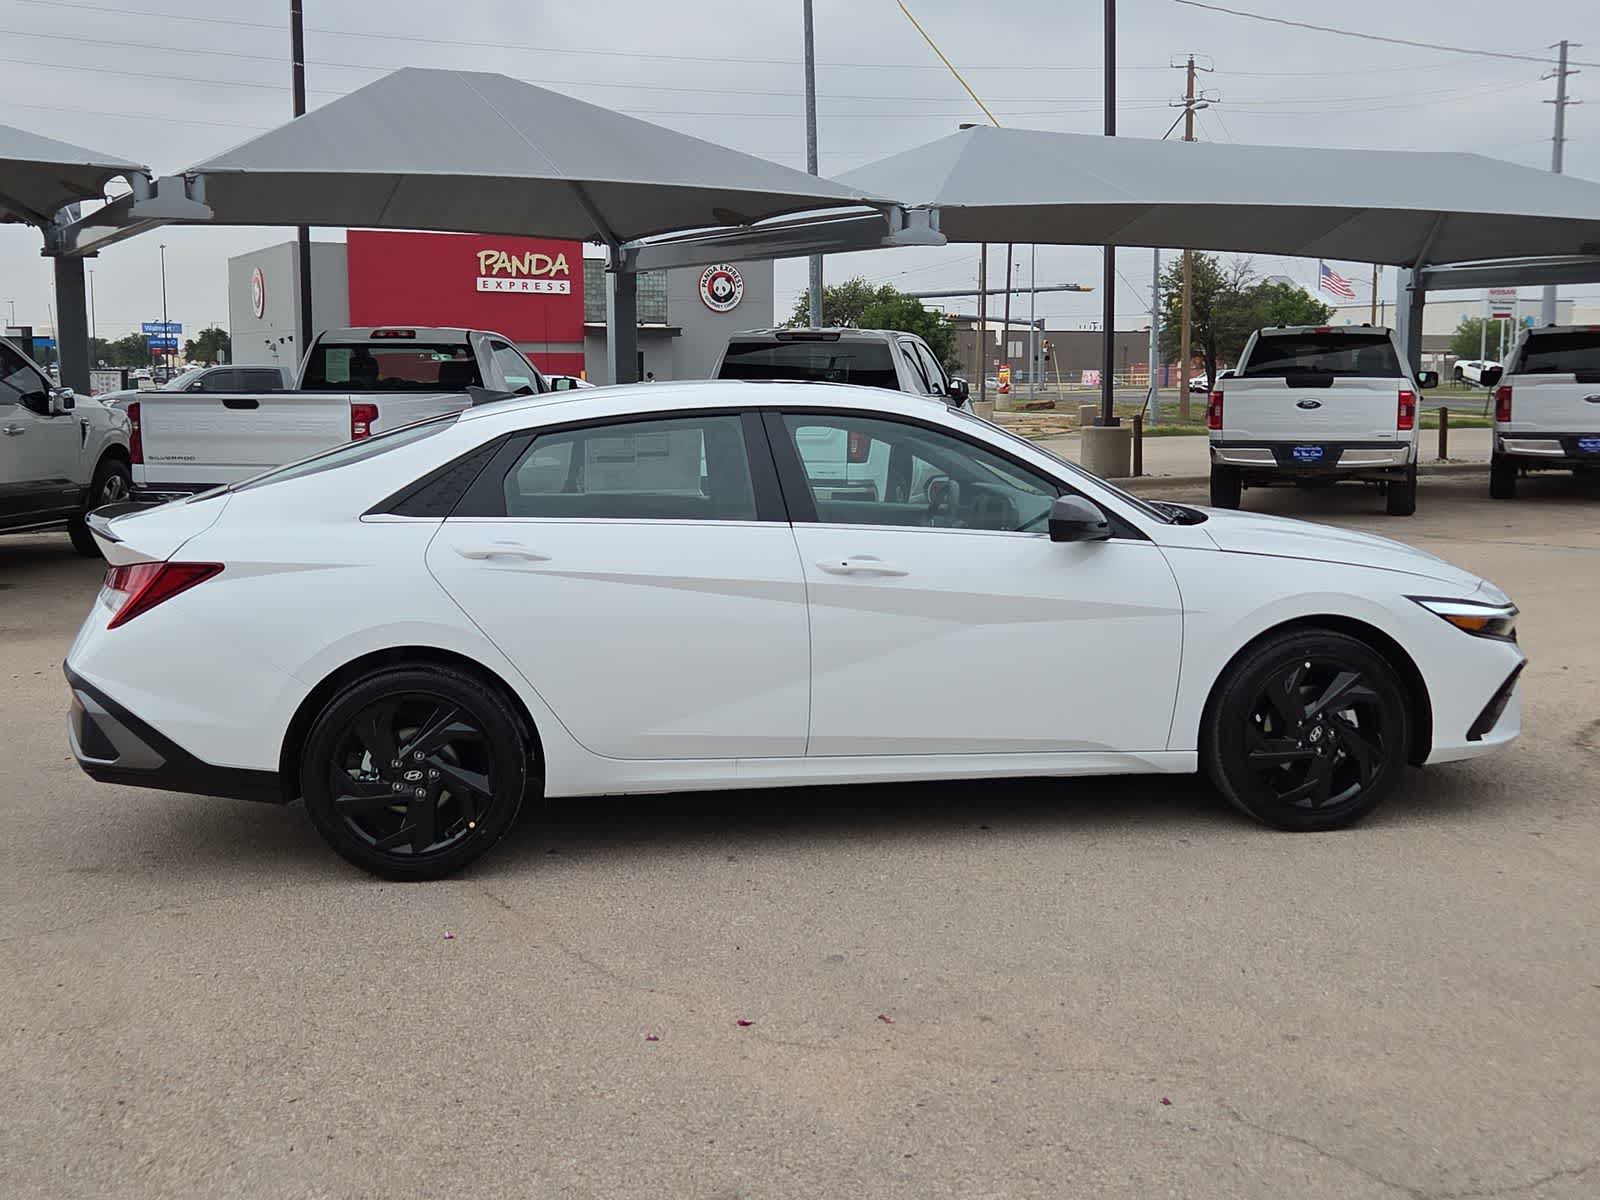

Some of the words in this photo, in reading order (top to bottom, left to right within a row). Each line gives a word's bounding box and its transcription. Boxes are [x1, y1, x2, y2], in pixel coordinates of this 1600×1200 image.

[476, 250, 569, 277] PANDA
[482, 280, 566, 292] EXPRESS
[702, 266, 718, 288] PANDA
[720, 265, 742, 289] EXPRESS
